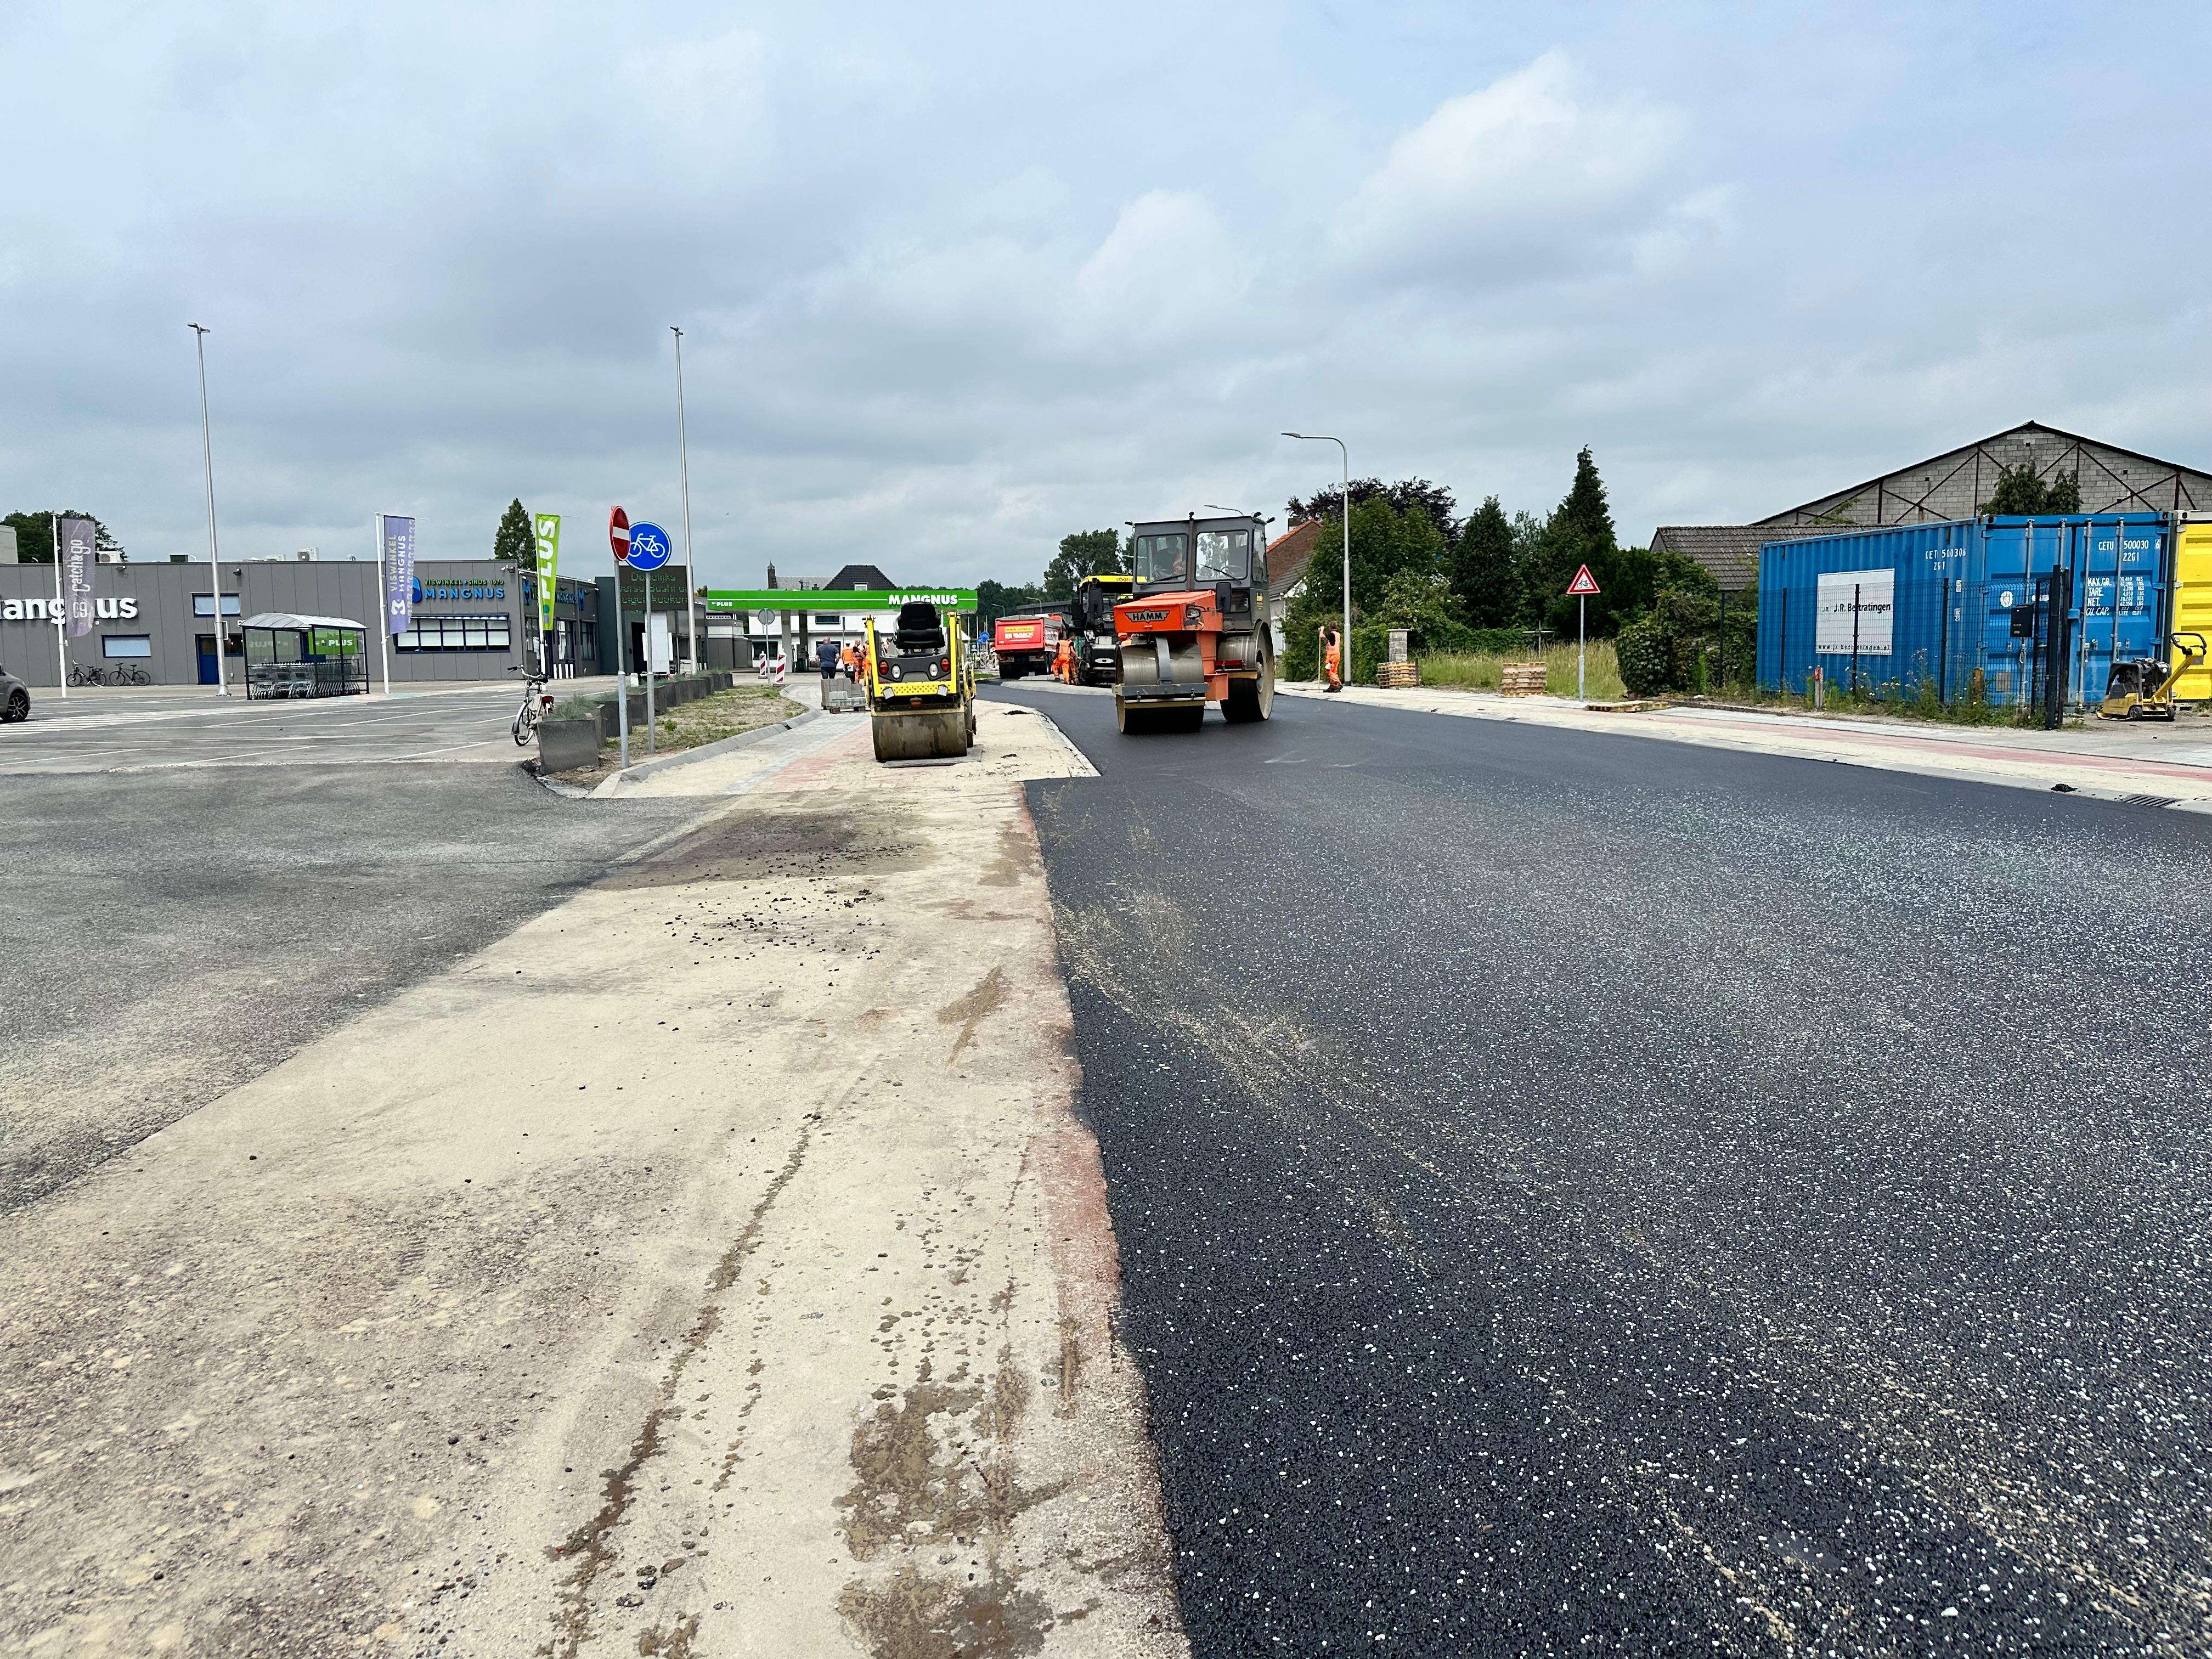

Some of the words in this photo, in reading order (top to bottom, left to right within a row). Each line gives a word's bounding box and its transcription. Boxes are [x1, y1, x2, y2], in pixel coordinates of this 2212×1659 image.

[2098, 541, 2114, 551] CETU
[2124, 540, 2149, 549] 500030
[2155, 540, 2160, 549] 6
[538, 519, 556, 600] PLUS
[2123, 552, 2139, 562] 22G1
[388, 534, 397, 592] VISWINKEL
[398, 535, 406, 592] MANGNUS
[424, 588, 504, 599] MANGNUS
[888, 595, 958, 605] MANGNUS
[1834, 604, 1846, 612] J.R.
[1848, 603, 1891, 614] Betratingen
[2096, 607, 2109, 616] CAP.
[1132, 612, 1163, 620] HAMM
